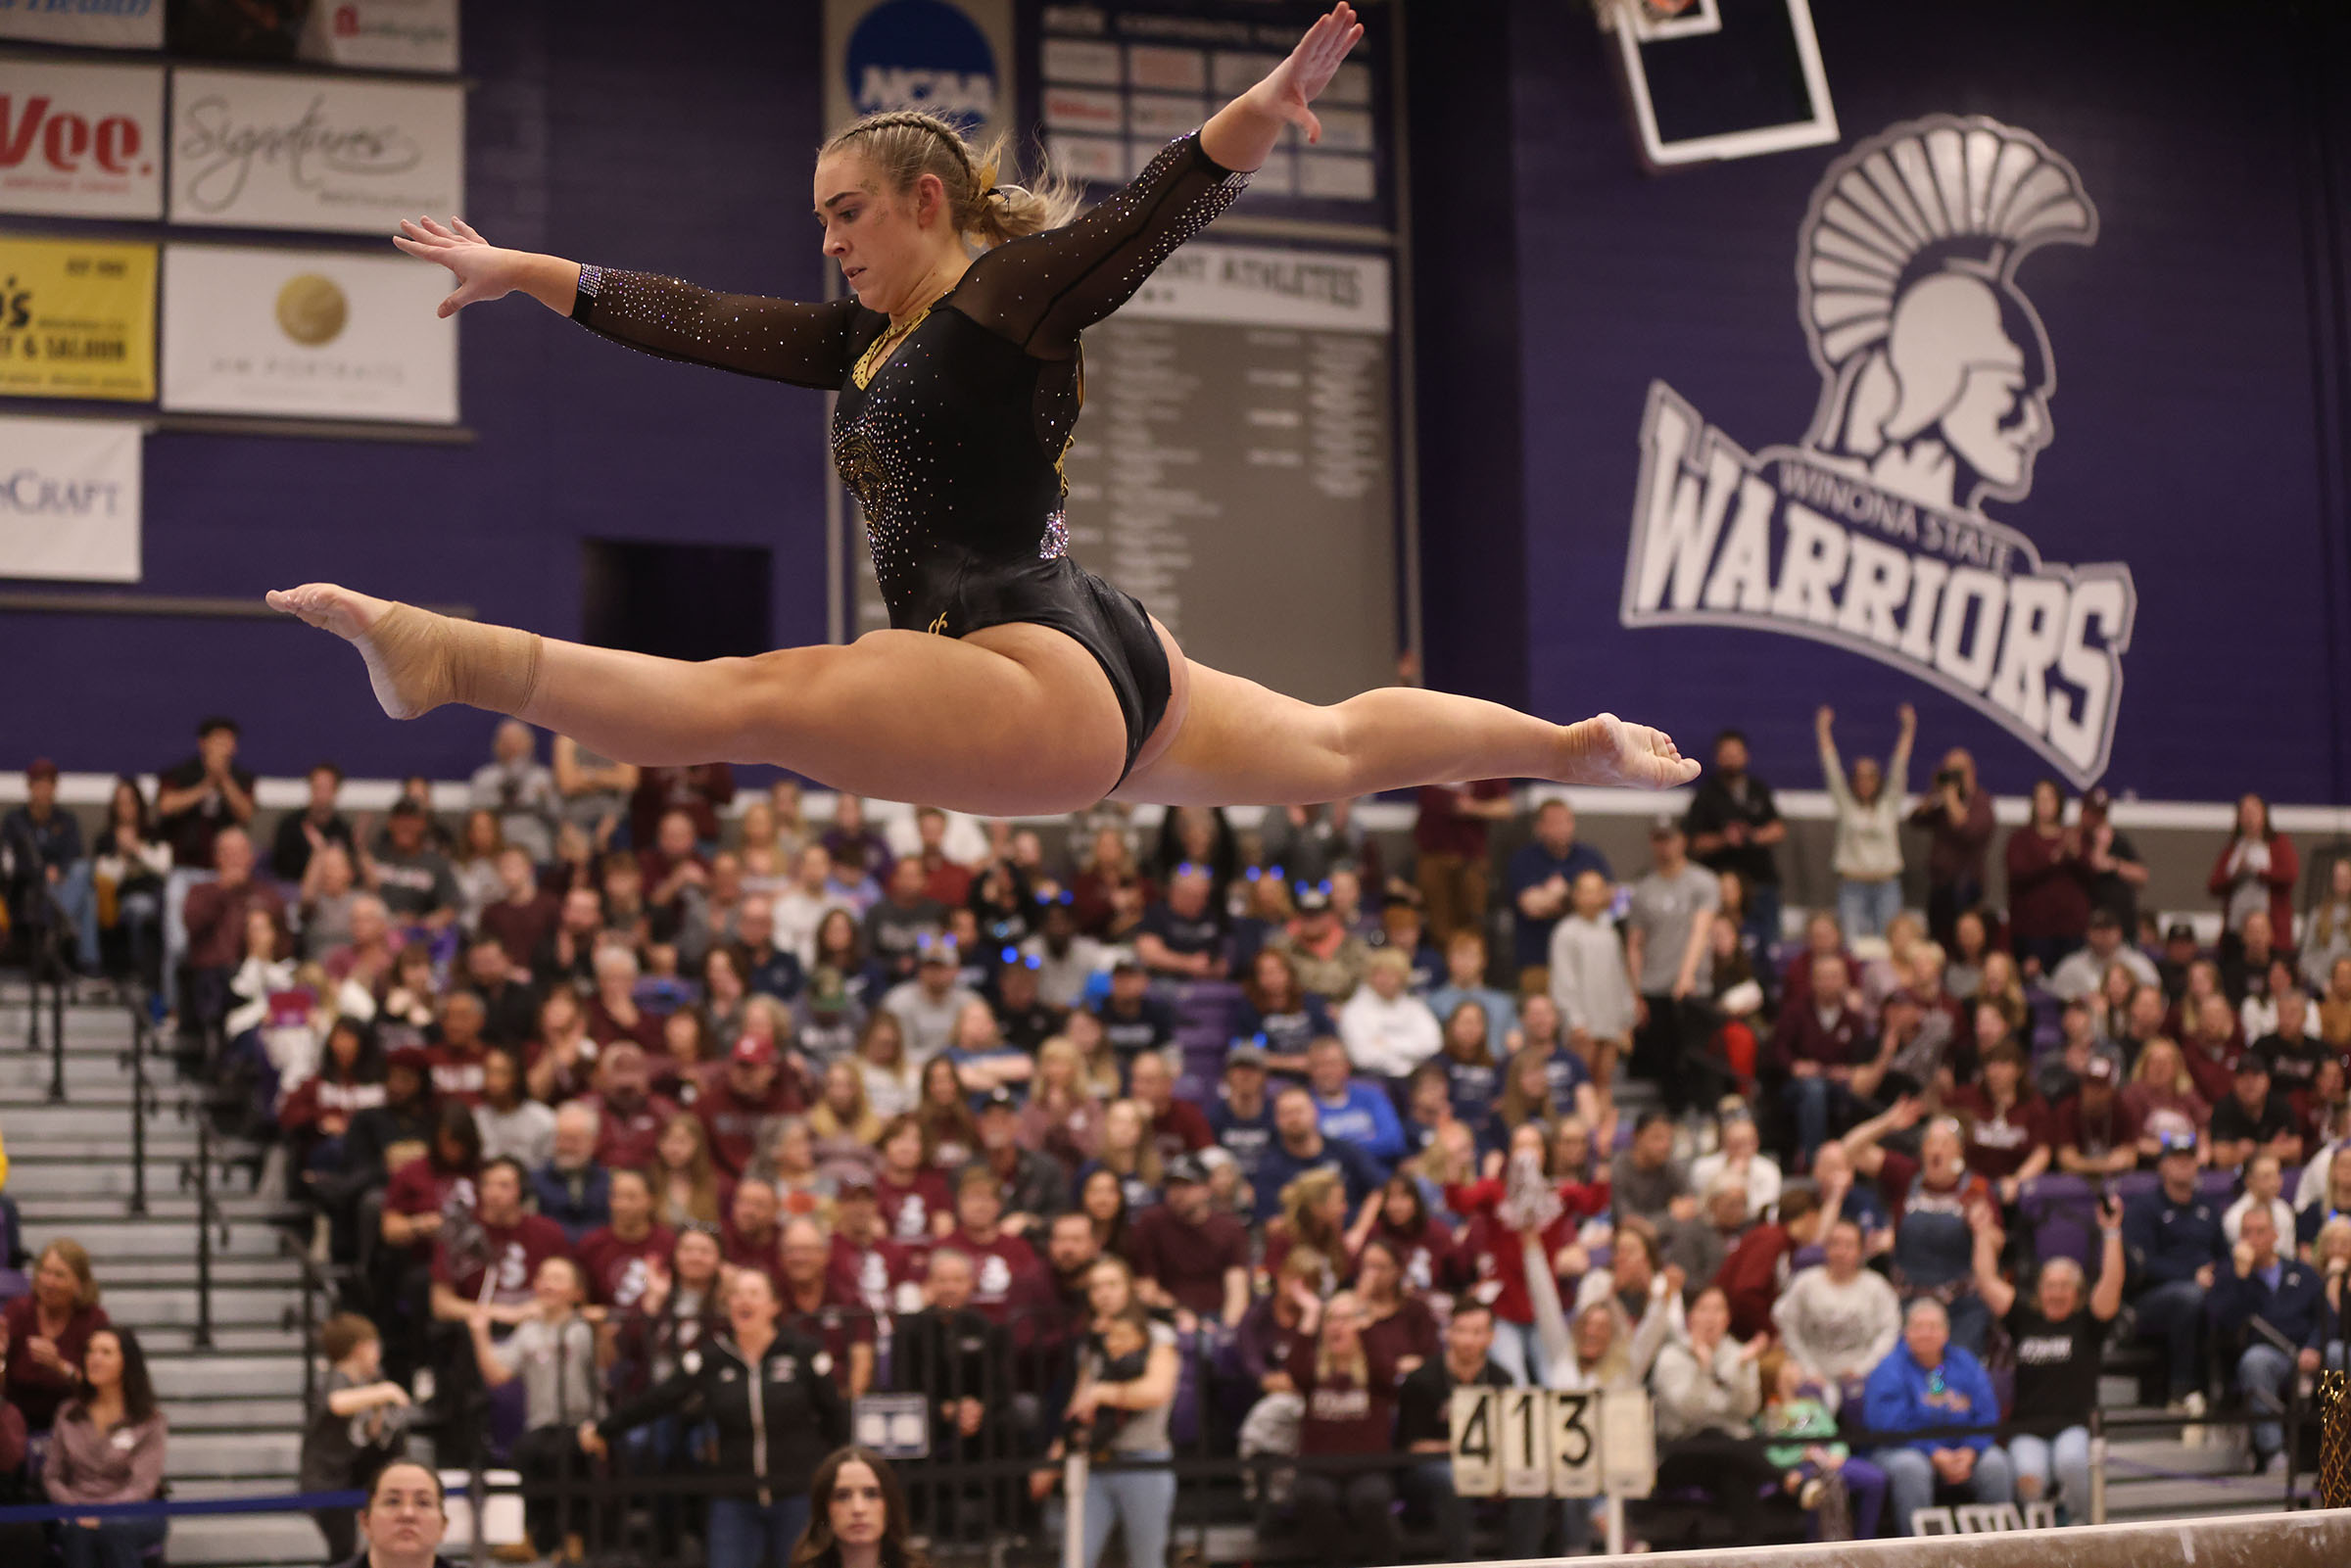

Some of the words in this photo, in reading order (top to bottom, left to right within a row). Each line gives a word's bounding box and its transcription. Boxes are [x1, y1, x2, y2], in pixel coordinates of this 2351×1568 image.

[860, 65, 993, 113] NCAA
[1220, 259, 1363, 309] ATHLETES
[1779, 460, 1916, 543] WINONA
[1923, 516, 2012, 574] STATE
[1638, 405, 2125, 770] WARRIORS
[1460, 1395, 1592, 1467] 413
